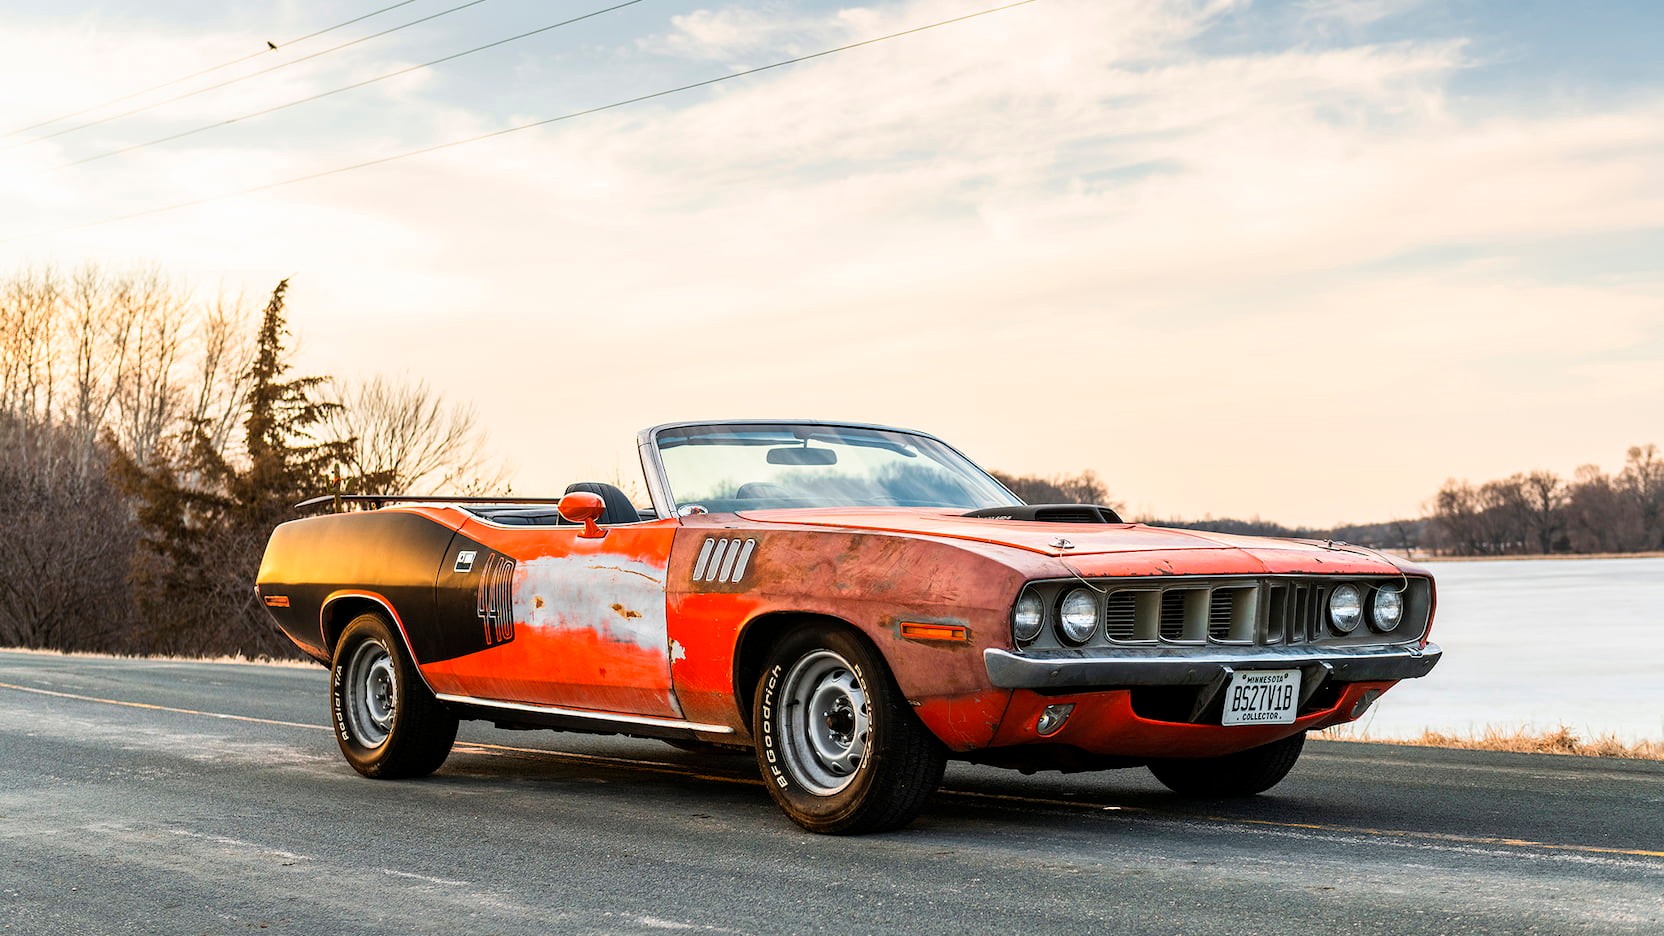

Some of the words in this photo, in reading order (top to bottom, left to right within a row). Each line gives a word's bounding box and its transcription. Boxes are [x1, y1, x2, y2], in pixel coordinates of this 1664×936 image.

[477, 552, 515, 645] 440
[334, 665, 343, 688] T/A
[1246, 675, 1284, 684] MINNESOTA
[1231, 684, 1293, 712] BS27V1B
[334, 692, 350, 741] Radial
[763, 664, 789, 790] BFGoodrich
[1242, 712, 1279, 721] COLLECTOR
